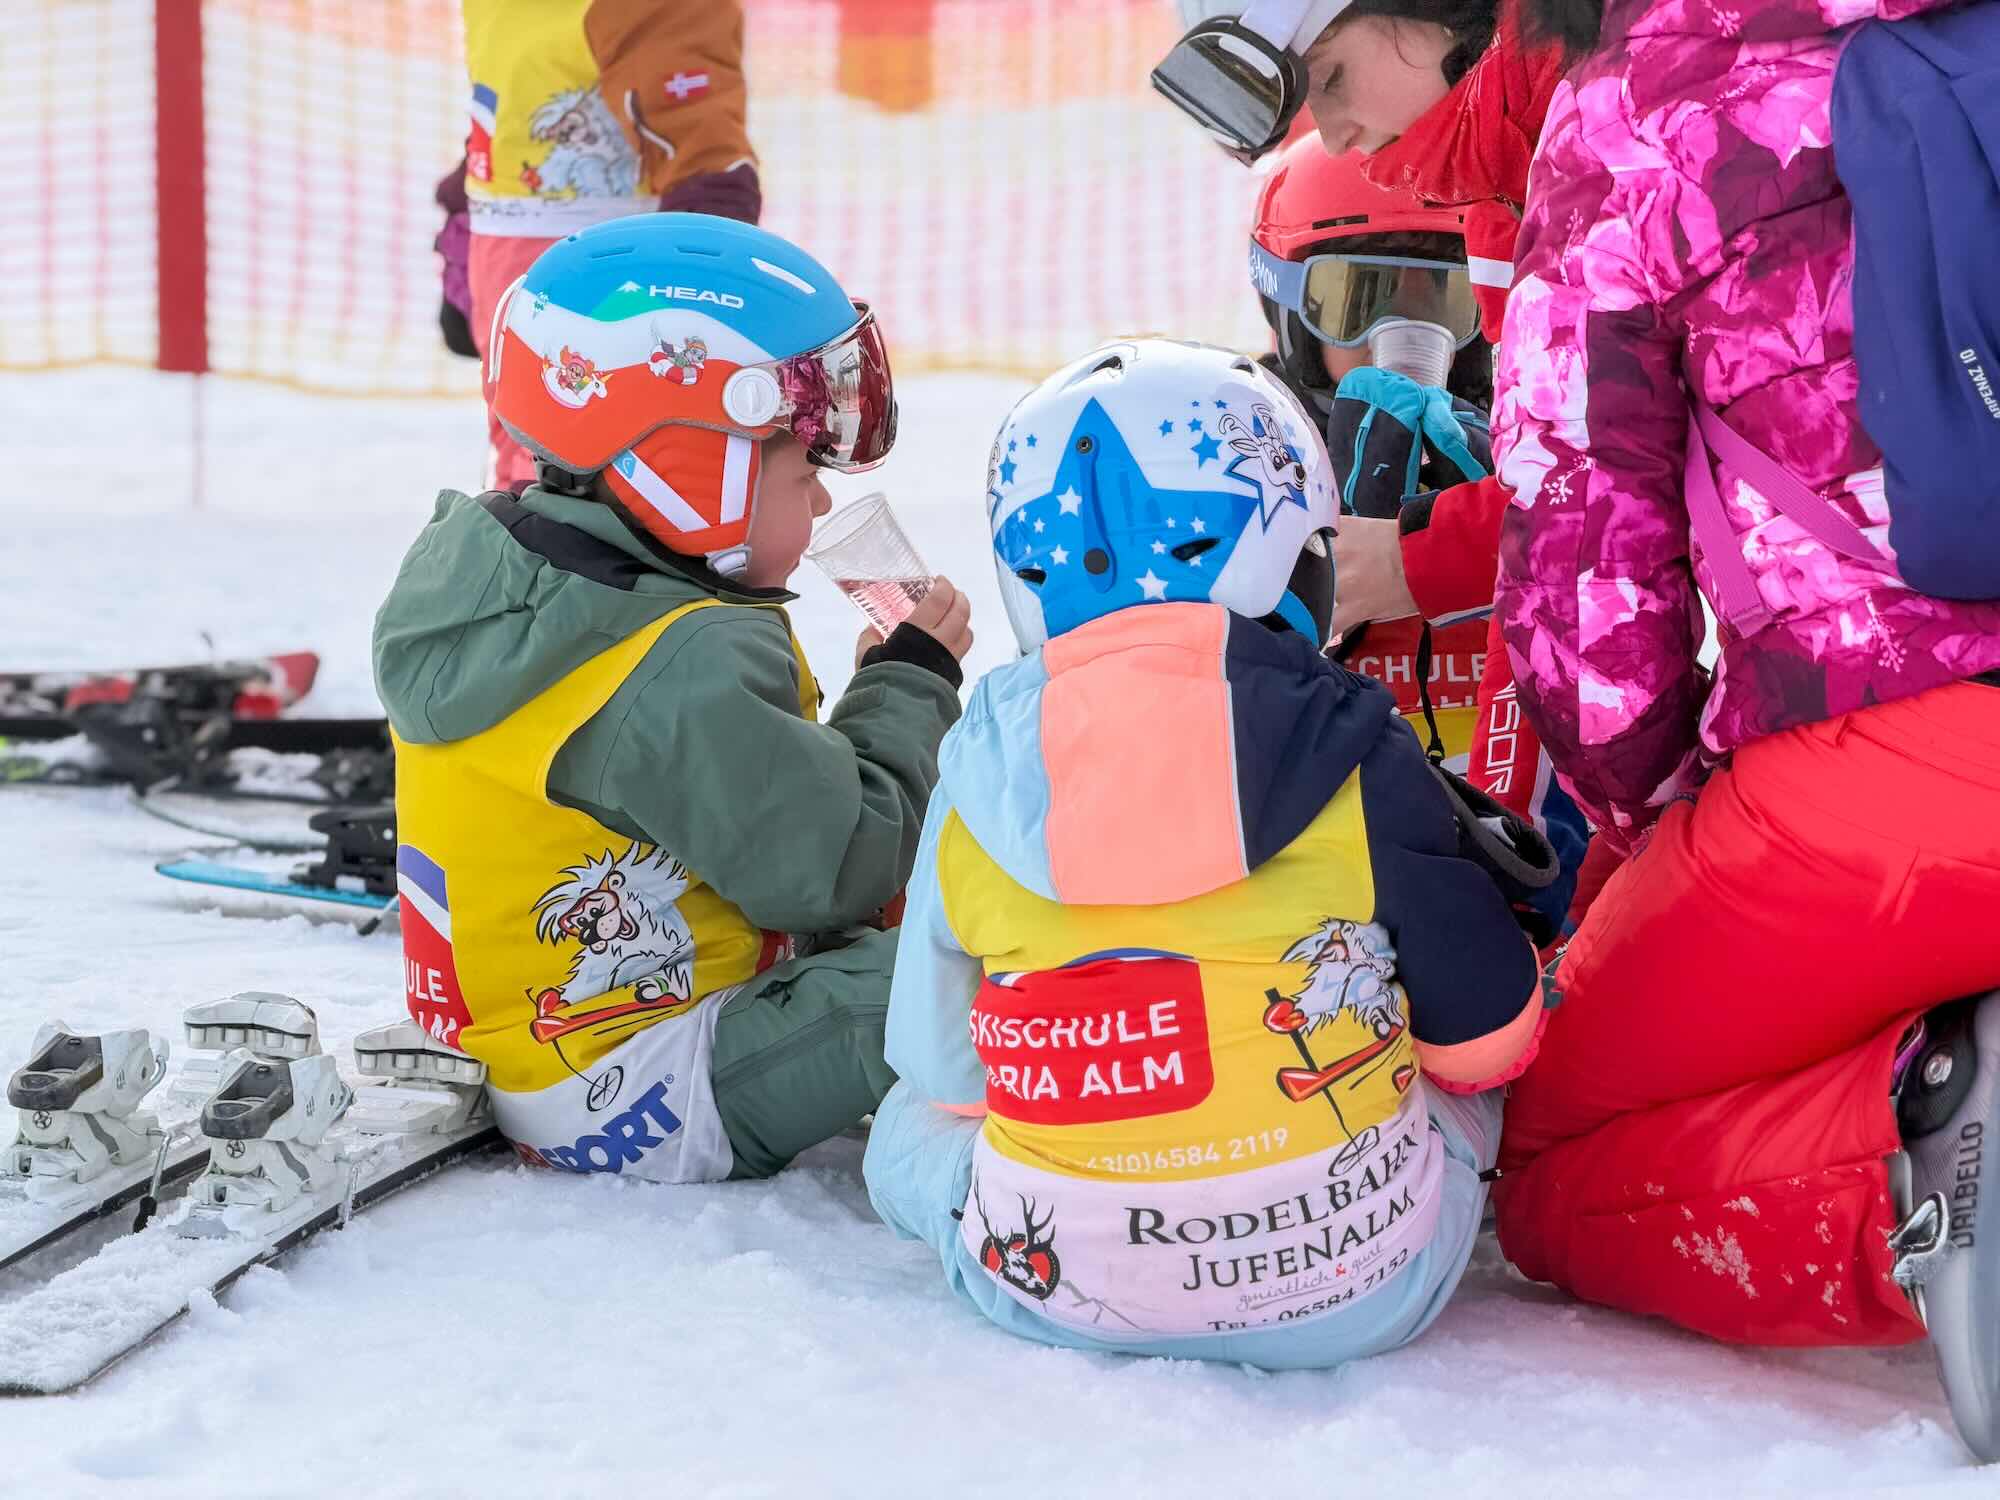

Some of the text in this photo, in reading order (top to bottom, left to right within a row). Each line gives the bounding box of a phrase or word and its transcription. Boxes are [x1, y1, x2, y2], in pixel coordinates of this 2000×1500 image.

[648, 284, 744, 309] HEAD
[968, 999, 1181, 1049] SKISCHULE
[1079, 1050, 1185, 1099] ALM
[1228, 1127, 1289, 1160] 2119
[1950, 1121, 1983, 1249] DALBELLO
[1182, 1184, 1417, 1291] JUFENALM
[1363, 1247, 1409, 1290] 7152
